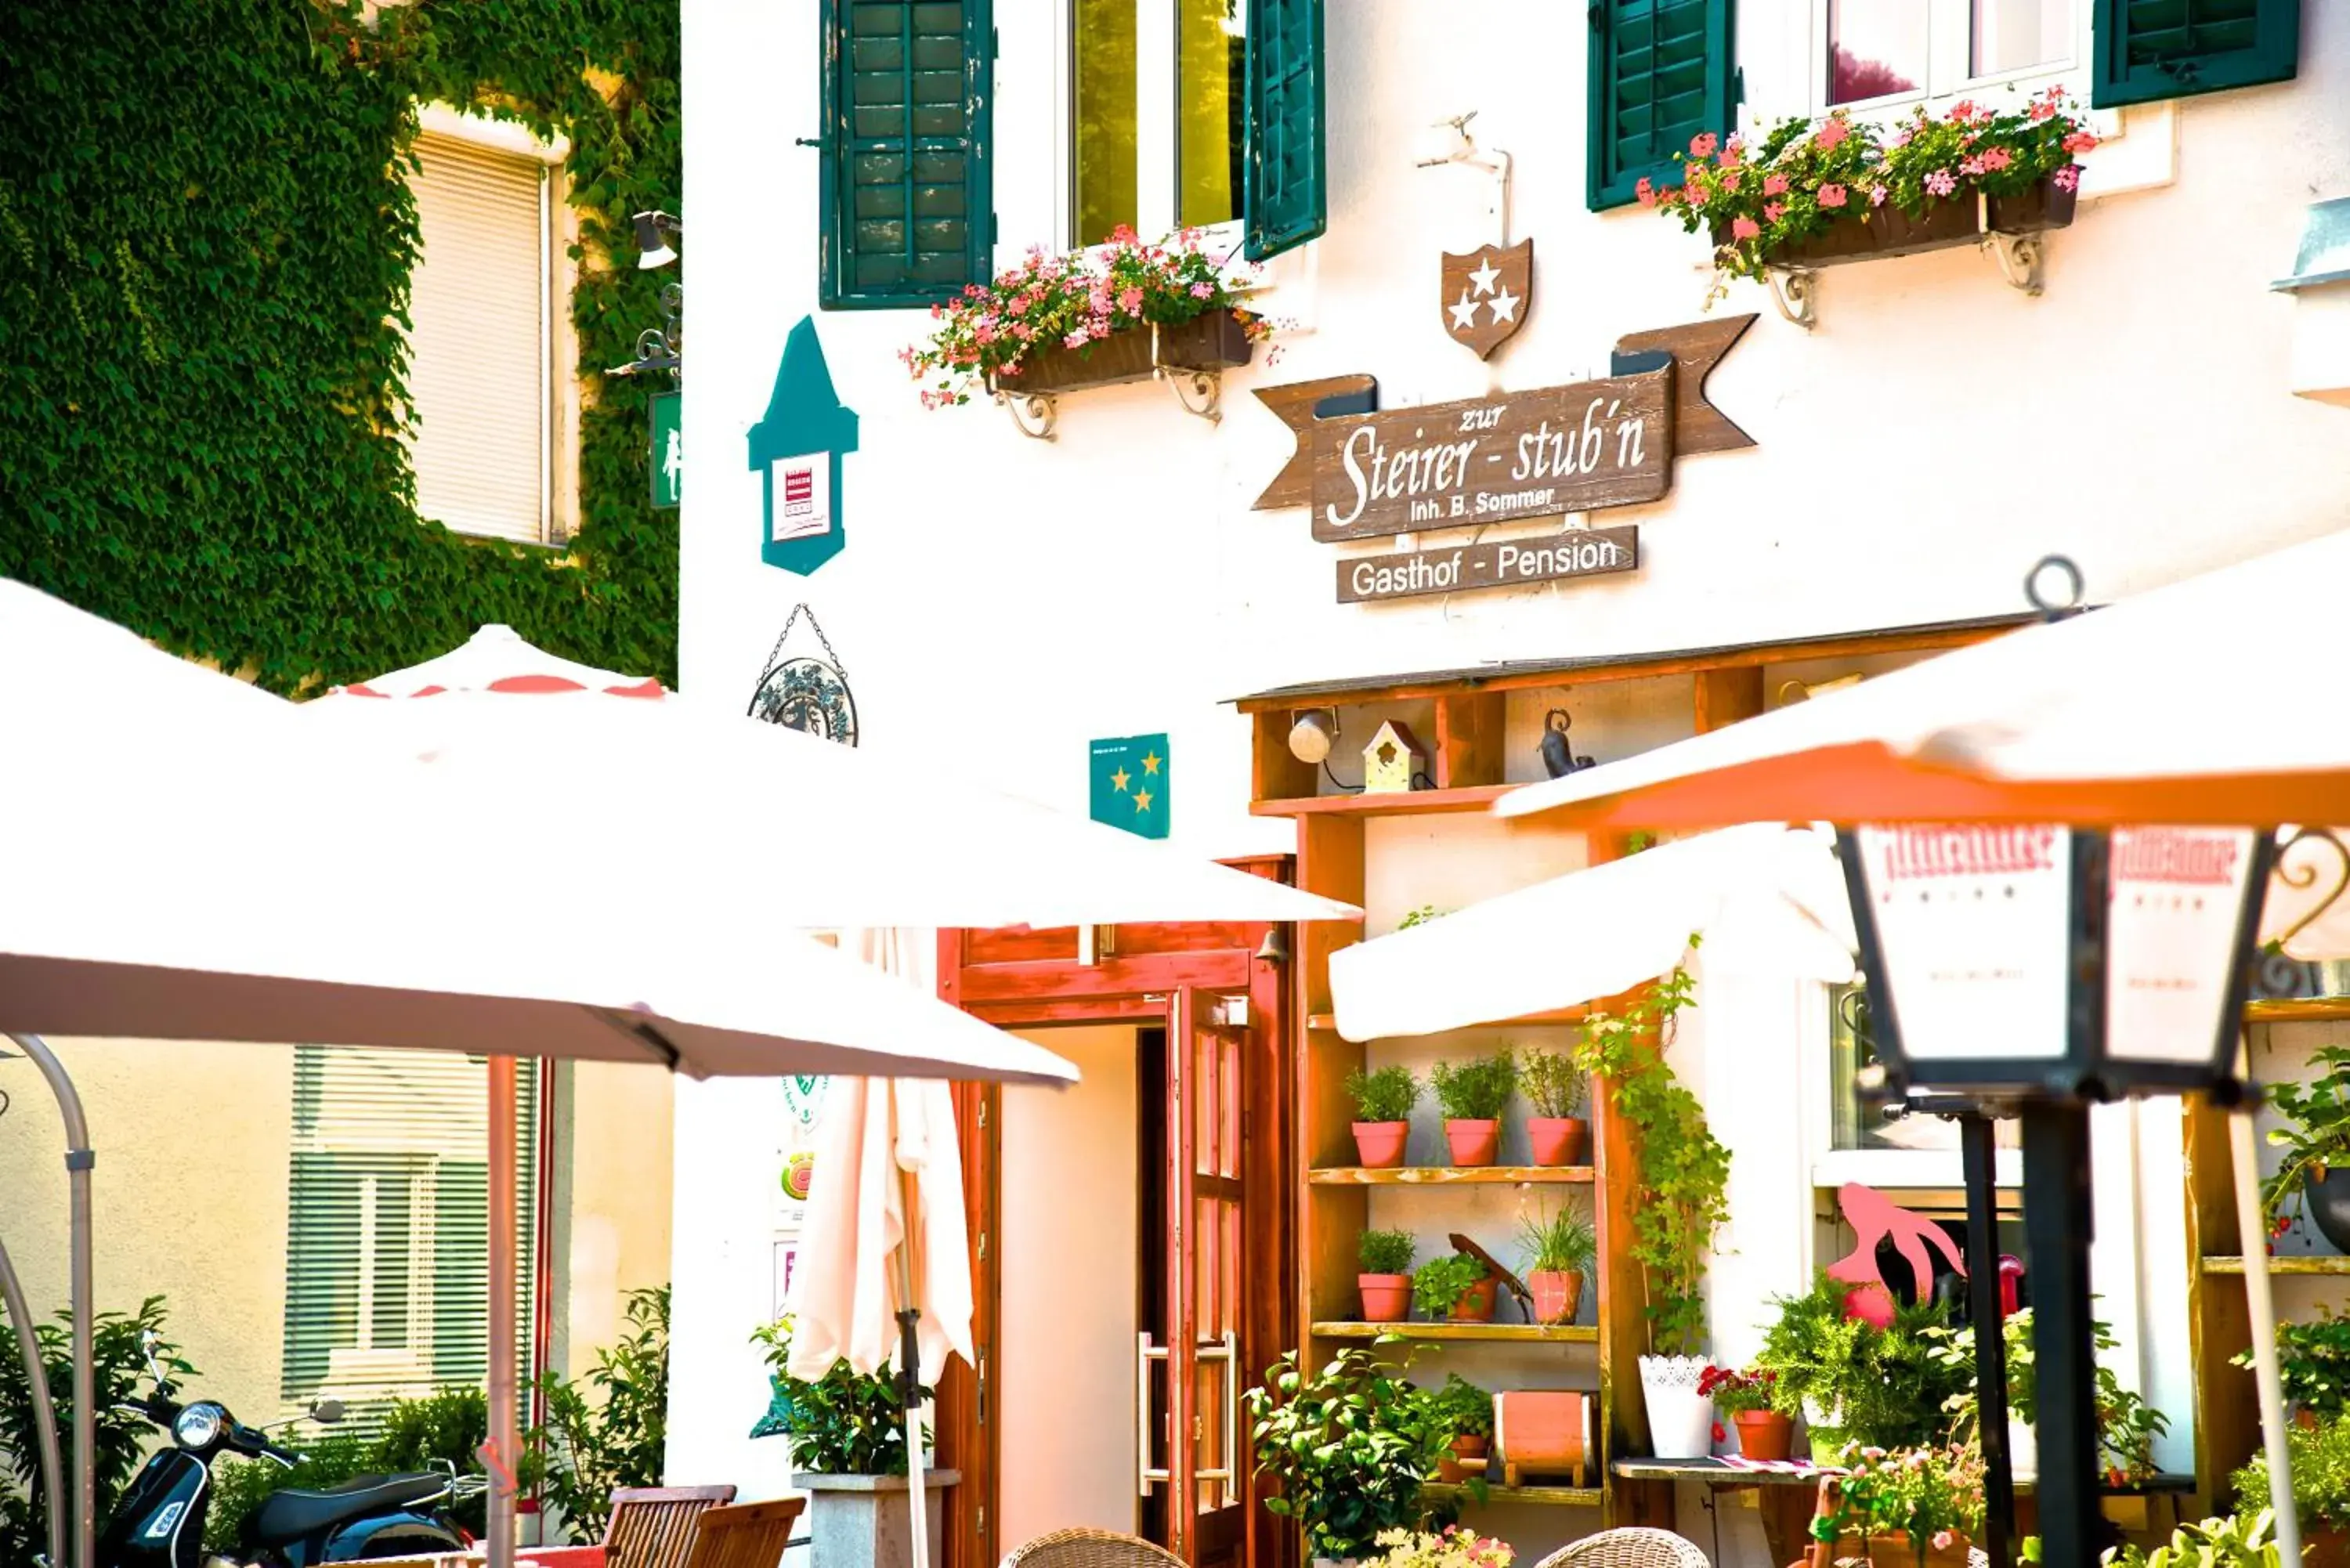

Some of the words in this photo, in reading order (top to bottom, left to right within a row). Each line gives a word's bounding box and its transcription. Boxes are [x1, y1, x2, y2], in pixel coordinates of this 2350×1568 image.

[1459, 404, 1506, 432] zur
[1326, 425, 1479, 526] Steirer
[1411, 500, 1444, 522] Inh.
[1452, 497, 1470, 517] B.
[1476, 488, 1555, 514] Sommer
[1352, 551, 1462, 595] Gasthof
[1498, 538, 1617, 579] Pension
